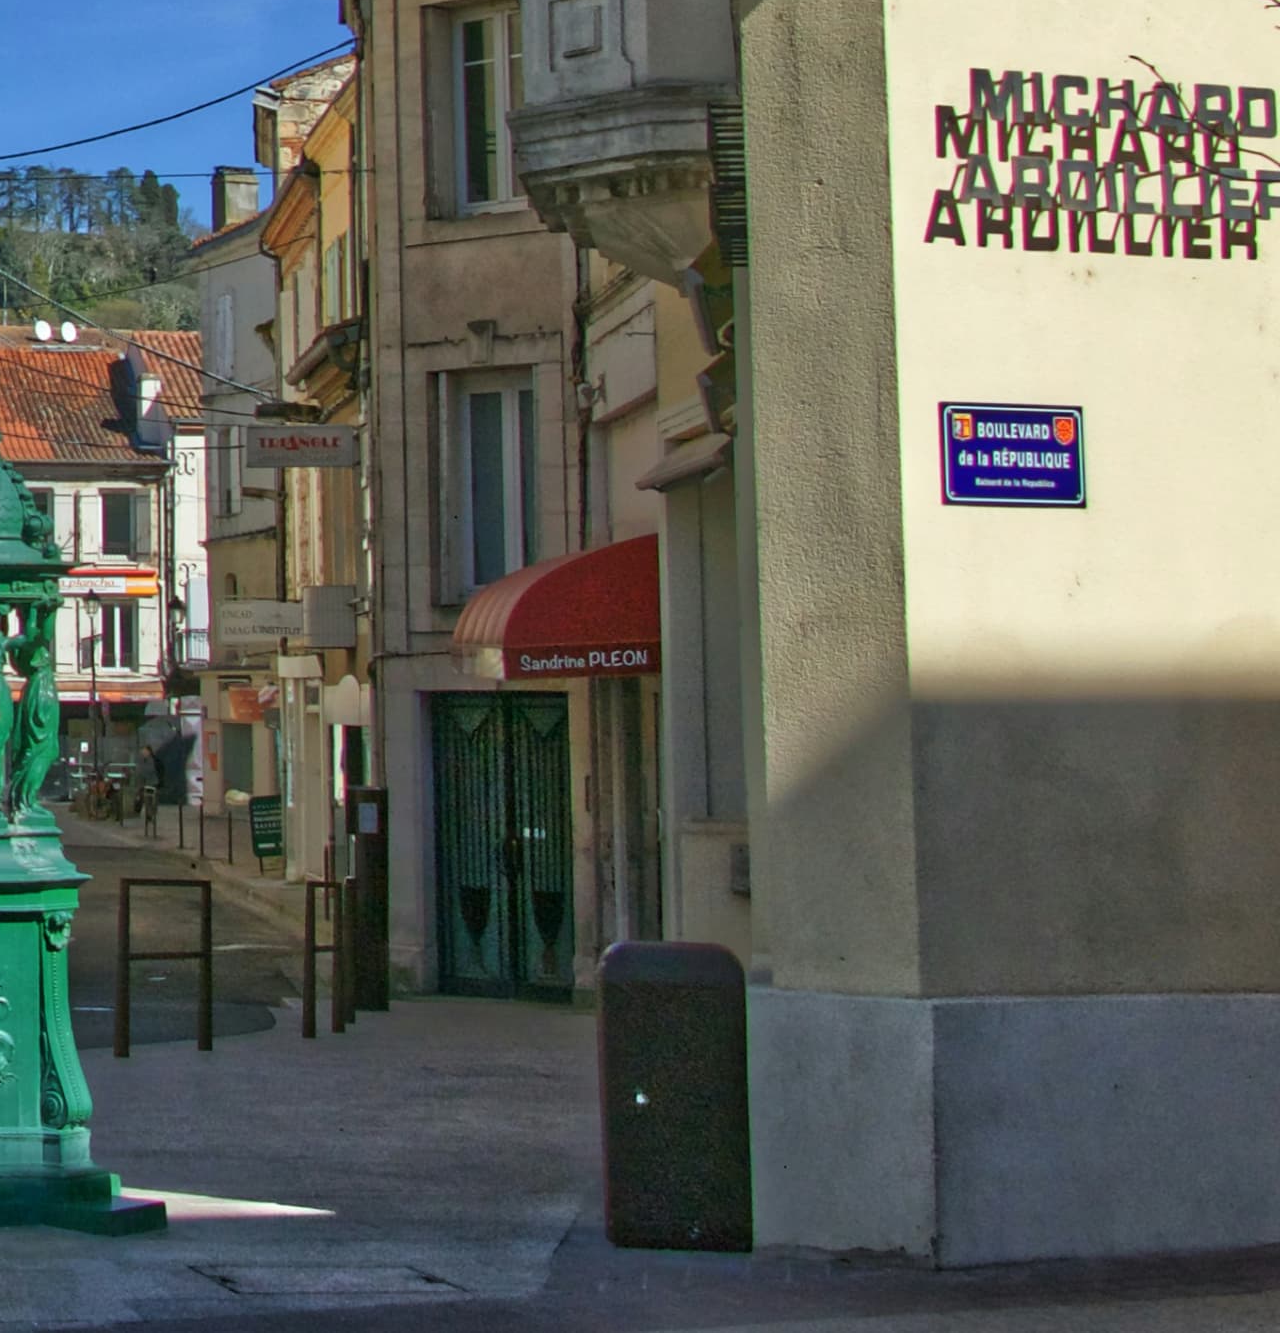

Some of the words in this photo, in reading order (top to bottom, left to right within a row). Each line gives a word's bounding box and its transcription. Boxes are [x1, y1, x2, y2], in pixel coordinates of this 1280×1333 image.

[969, 67, 1277, 139] MICHARD
[976, 421, 1050, 440] BOULEVARD
[258, 435, 342, 451] TRIANGLE
[957, 449, 974, 466] de
[977, 450, 989, 467] la
[992, 447, 1071, 469] RÉPUBLIQUE
[520, 654, 586, 672] Sandrine
[588, 649, 648, 667] PLEON
